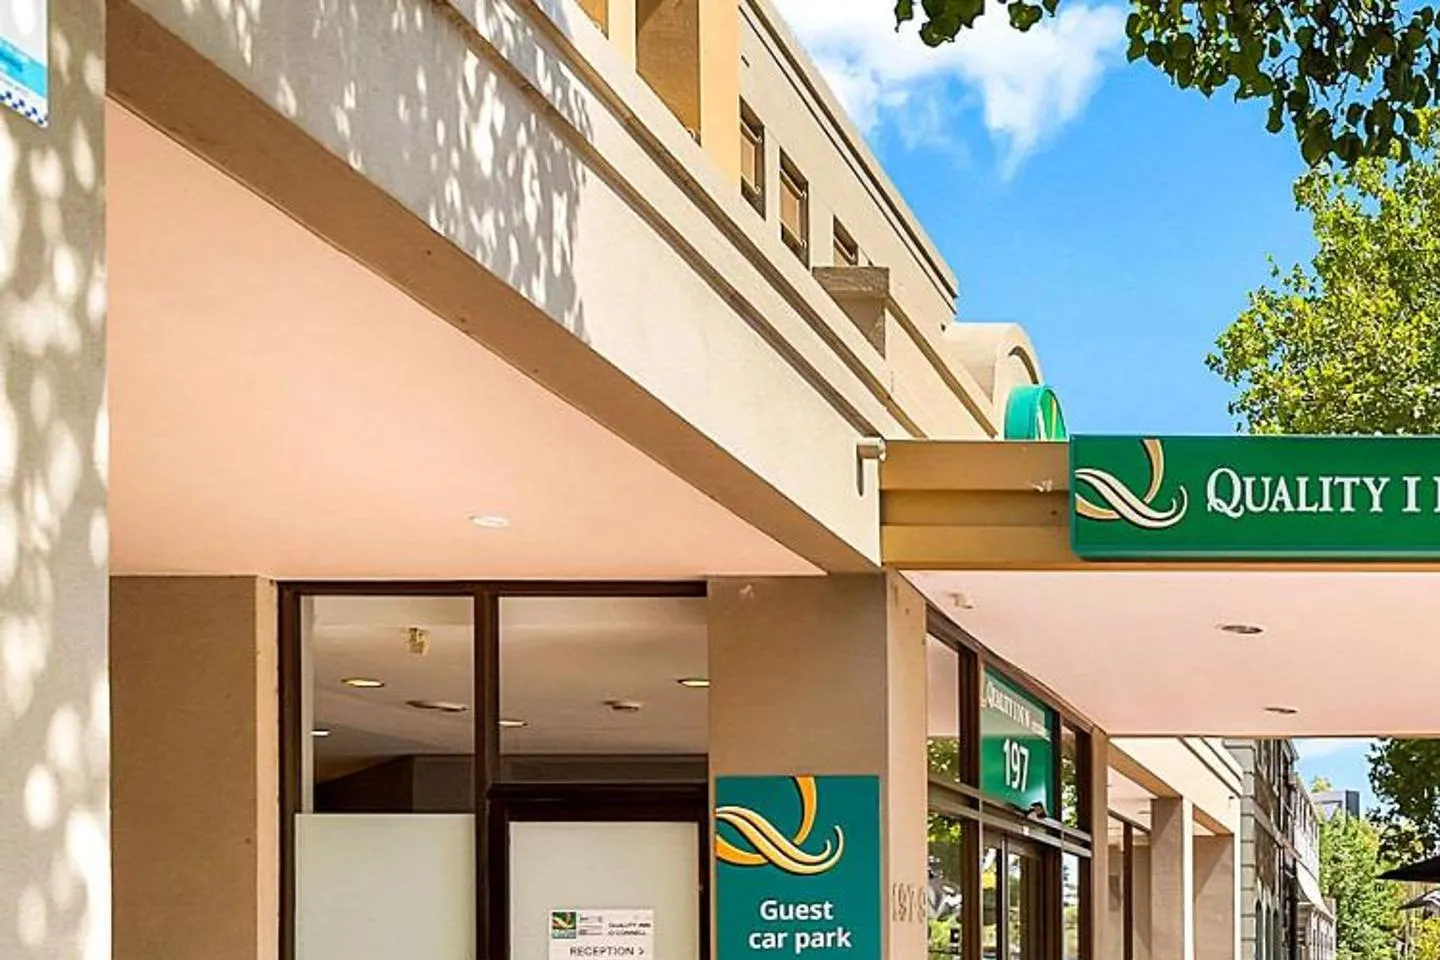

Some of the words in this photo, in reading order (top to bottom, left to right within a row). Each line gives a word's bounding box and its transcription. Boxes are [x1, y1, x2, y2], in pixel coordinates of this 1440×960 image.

[1206, 467, 1390, 517] QUALITY
[1003, 738, 1030, 793] 197
[760, 900, 834, 921] Guest
[569, 946, 635, 956] RECEPTION
[749, 932, 788, 950] car
[794, 926, 852, 954] park
